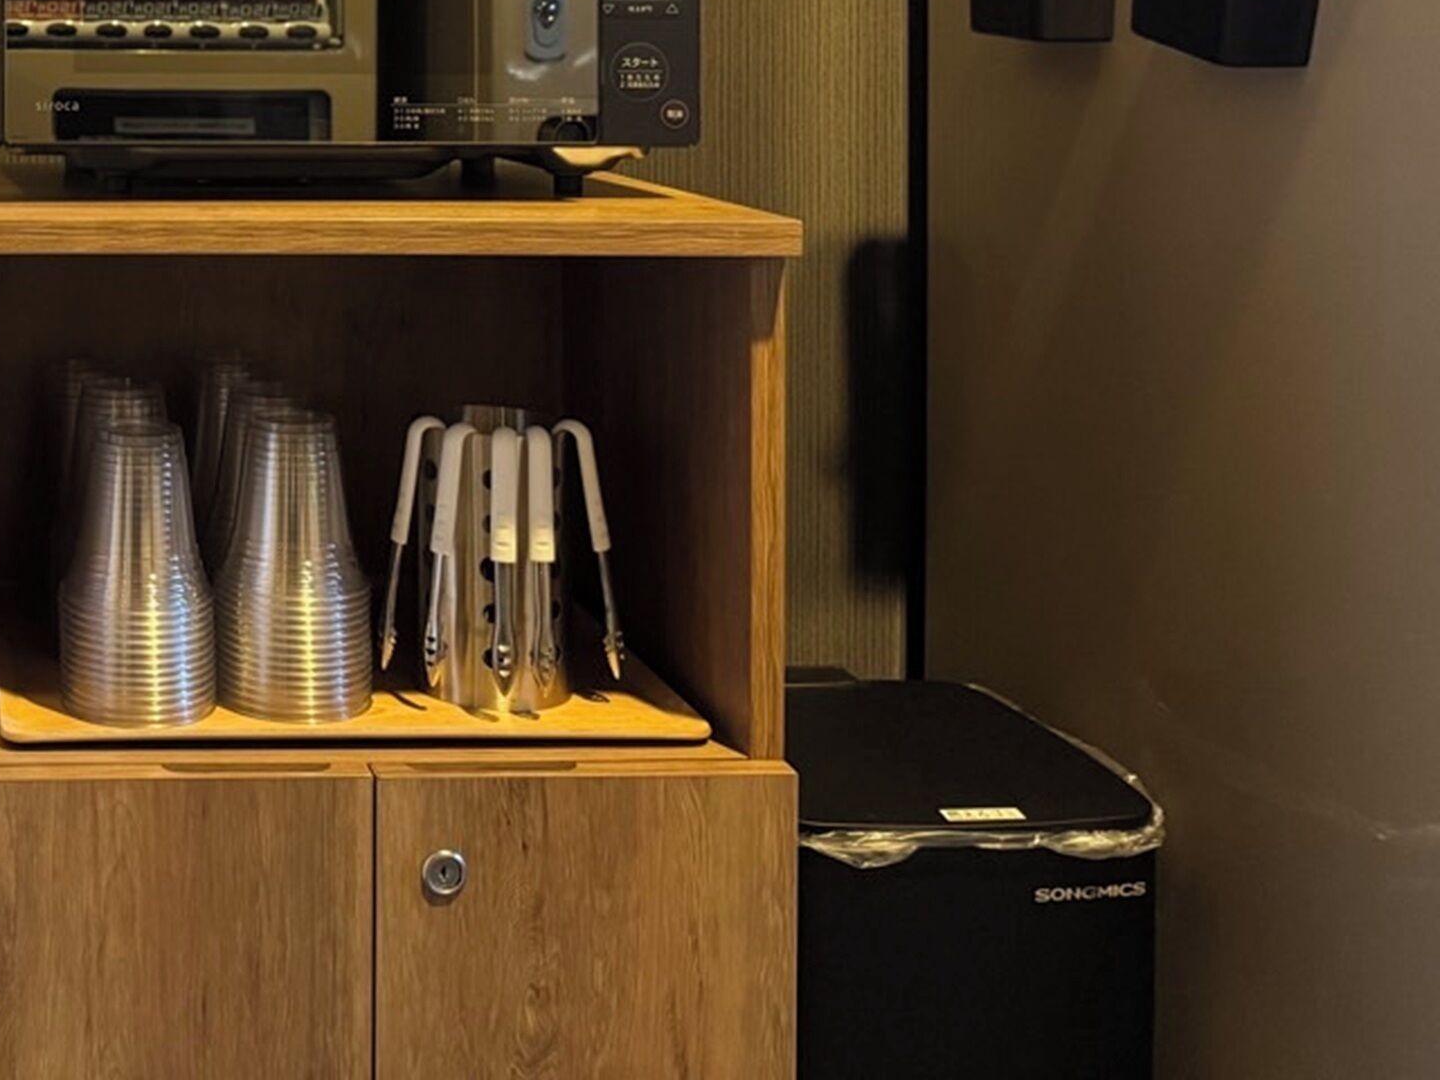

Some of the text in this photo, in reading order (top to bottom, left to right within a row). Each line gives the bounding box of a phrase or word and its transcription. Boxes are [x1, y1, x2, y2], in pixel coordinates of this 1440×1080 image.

[621, 57, 660, 68] スタート
[35, 100, 80, 113] siroca
[1034, 881, 1147, 904] SONGMICS
